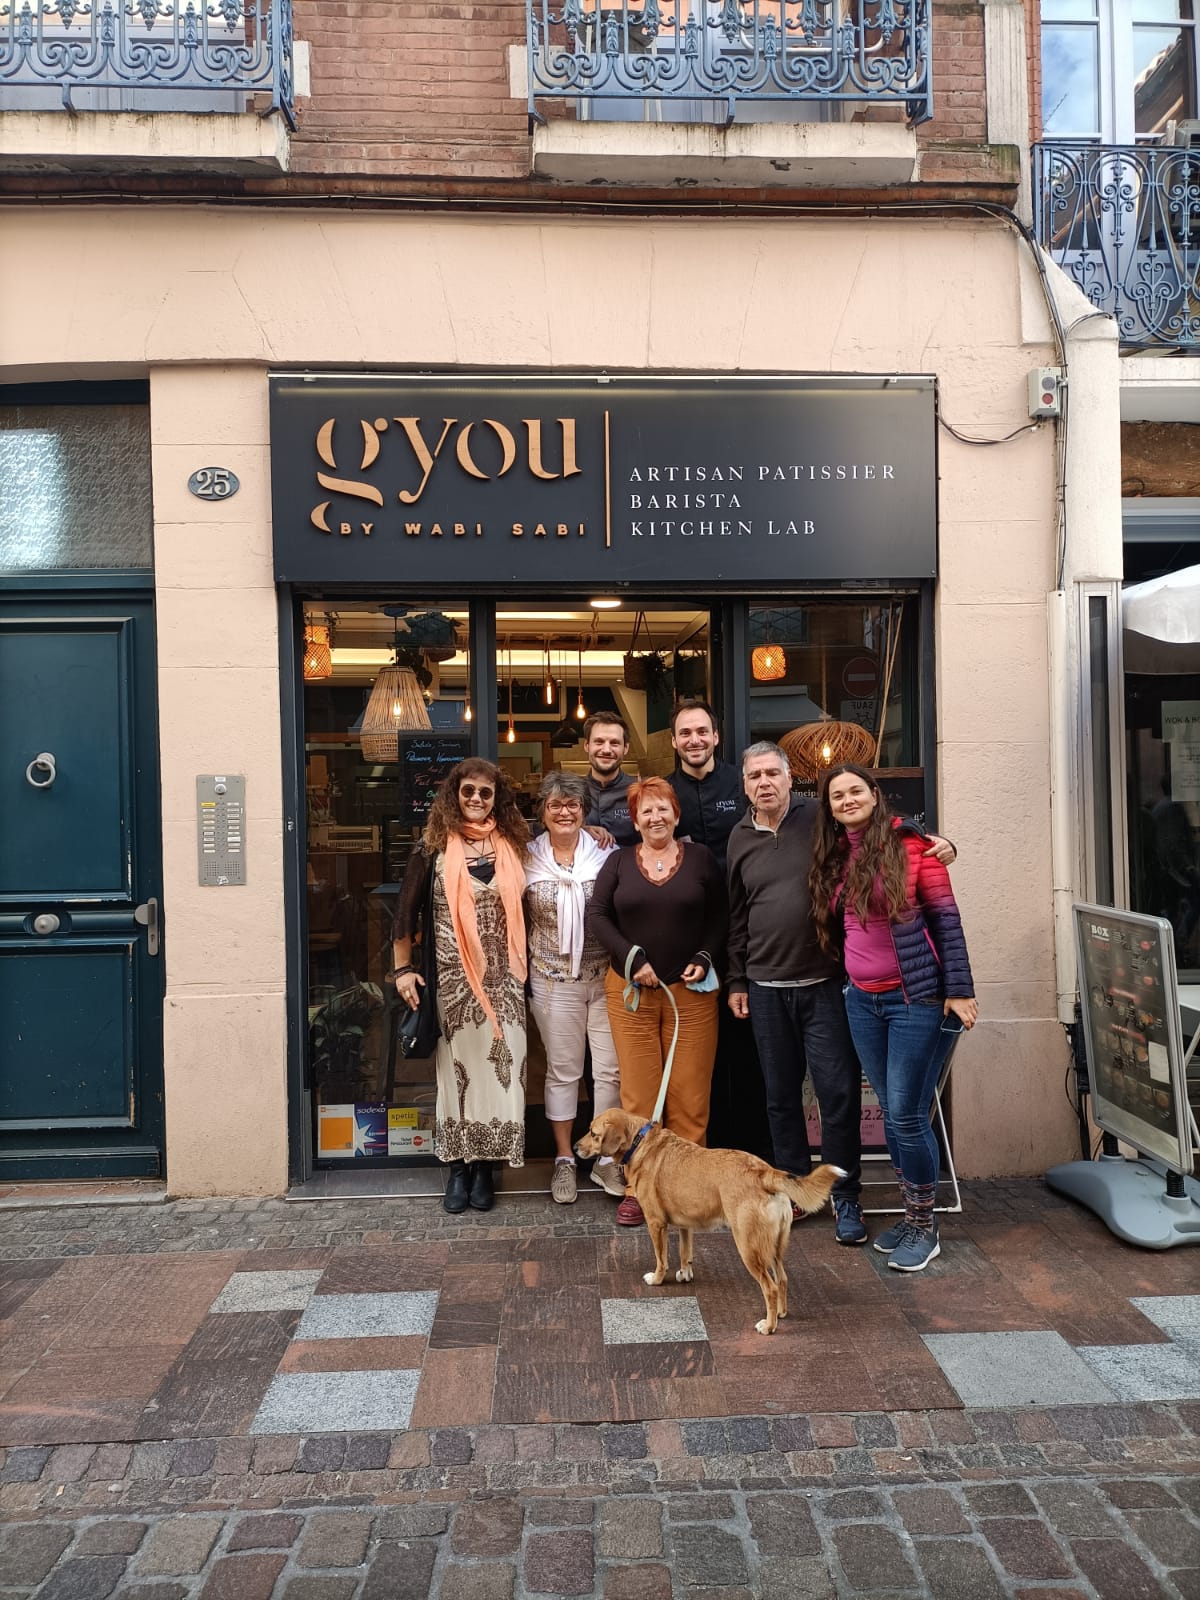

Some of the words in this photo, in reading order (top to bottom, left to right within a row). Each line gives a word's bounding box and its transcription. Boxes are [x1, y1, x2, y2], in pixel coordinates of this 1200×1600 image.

[310, 417, 583, 533] gyou
[629, 466, 745, 482] ARTISAN
[758, 464, 896, 481] PATISSIER
[197, 470, 230, 495] 25
[630, 493, 742, 509] BARISTA
[340, 522, 375, 536] BY
[405, 522, 483, 536] WABI
[512, 522, 586, 536] SABI
[631, 520, 753, 536] KITCHEN
[768, 520, 816, 535] LAB
[1091, 924, 1110, 937] BOX
[357, 1105, 386, 1114] sodexo
